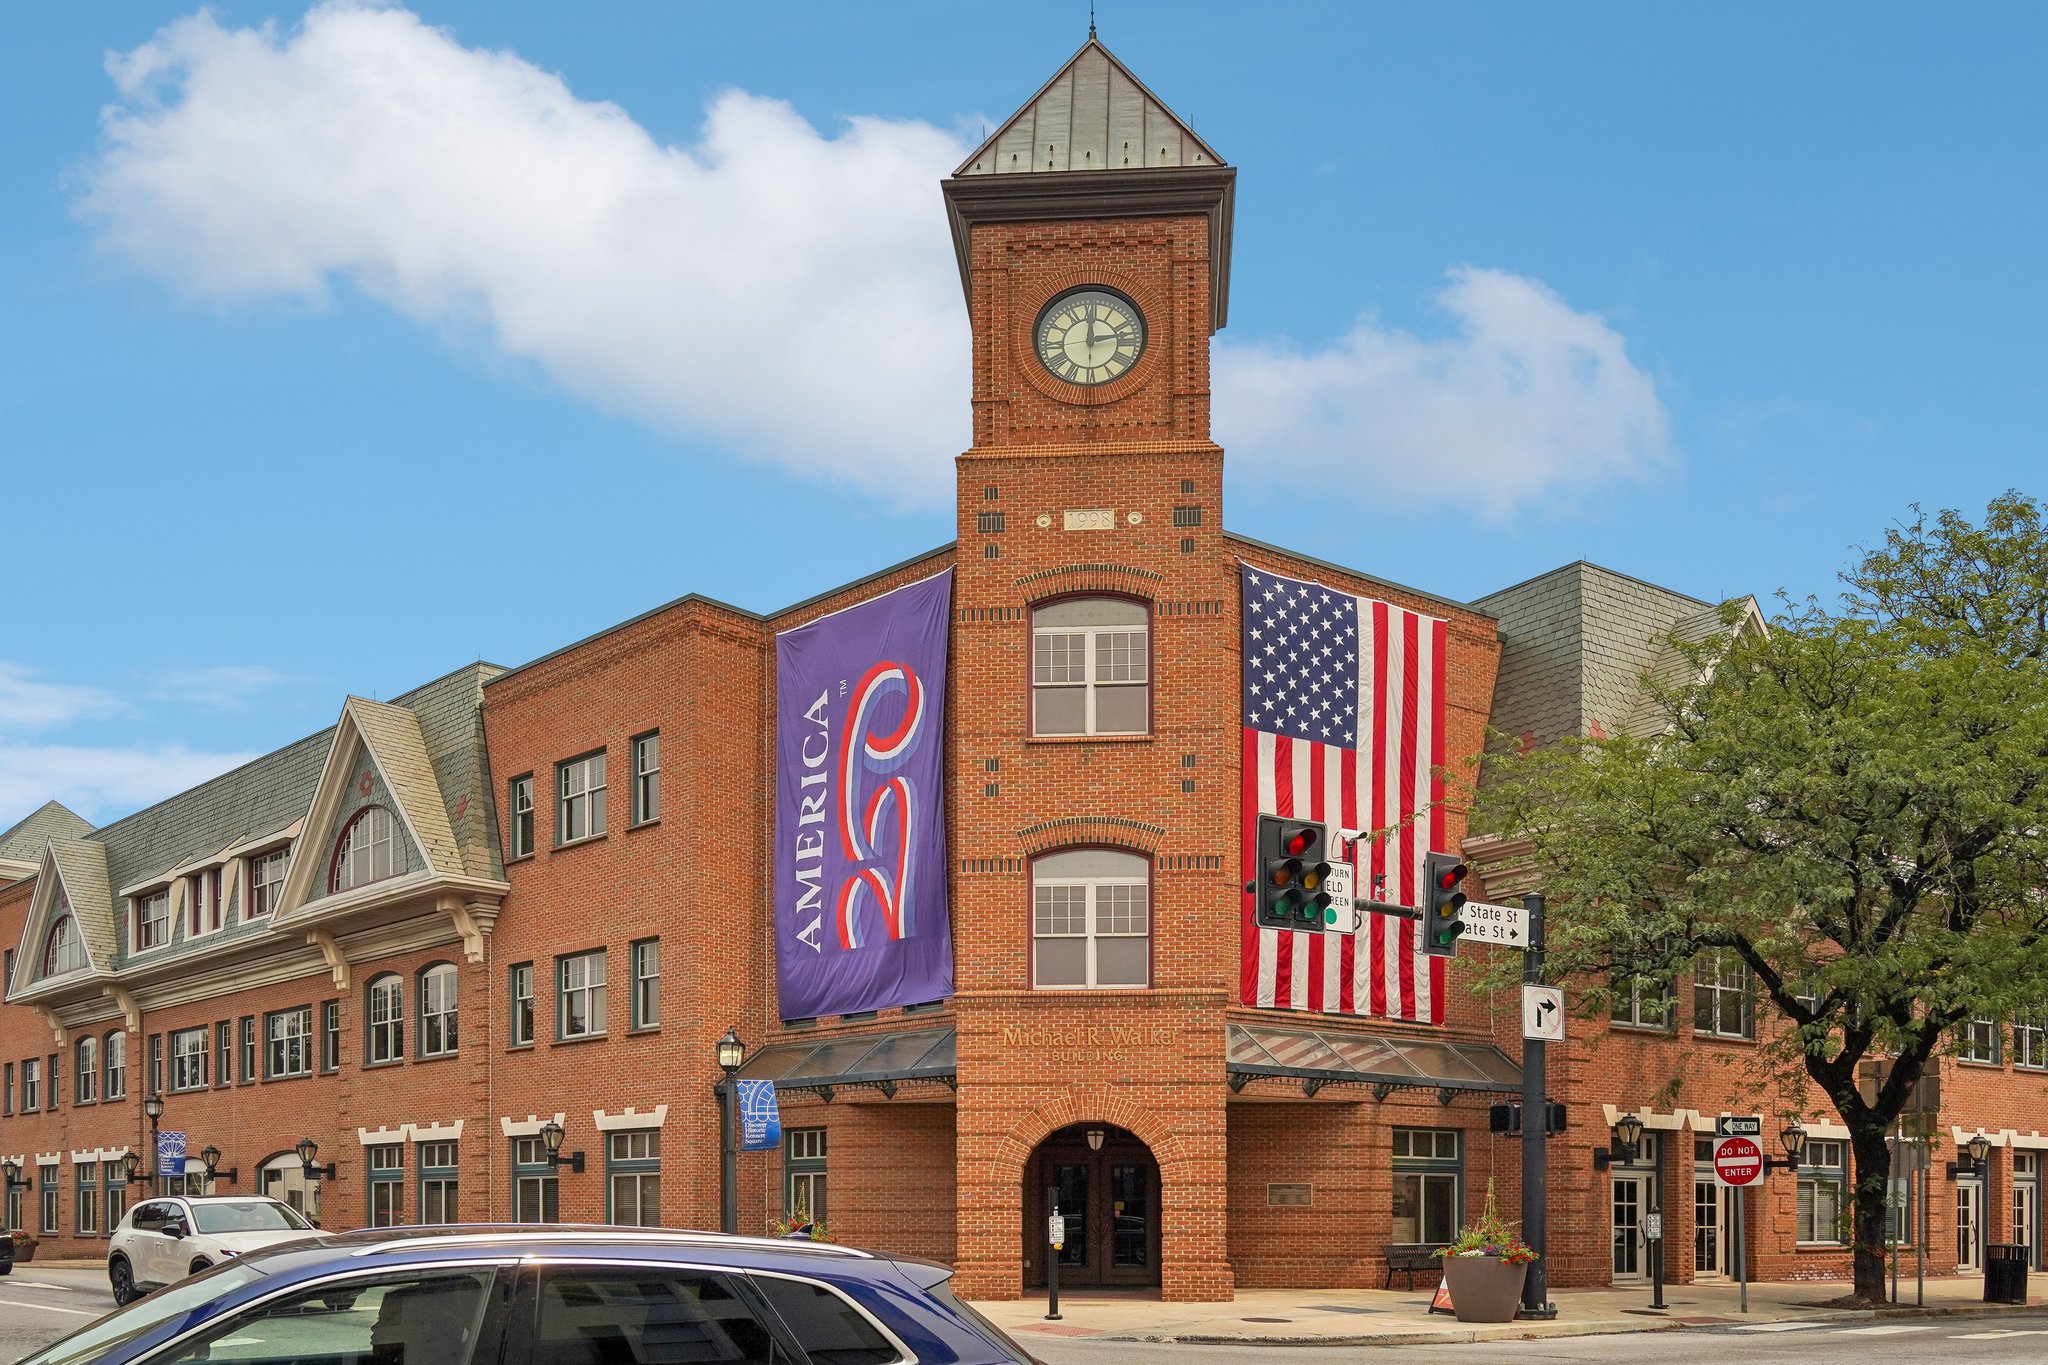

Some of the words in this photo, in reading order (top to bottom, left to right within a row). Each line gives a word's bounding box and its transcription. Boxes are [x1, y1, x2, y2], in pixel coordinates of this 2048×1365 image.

[1069, 512, 1110, 528] 1998
[796, 689, 829, 954] AMERICA
[1331, 867, 1350, 879] TURN
[1326, 880, 1343, 893] ELD
[1330, 896, 1350, 907] REEN
[1470, 905, 1501, 921] State
[1506, 910, 1518, 924] St
[1465, 922, 1486, 937] ate
[1492, 925, 1505, 939] St
[1002, 1026, 1082, 1047] Michael
[1108, 1026, 1179, 1047] Walker
[1052, 1051, 1124, 1062] BUILDING
[1737, 1146, 1755, 1155] NOT
[1725, 1168, 1752, 1176] ENTER
